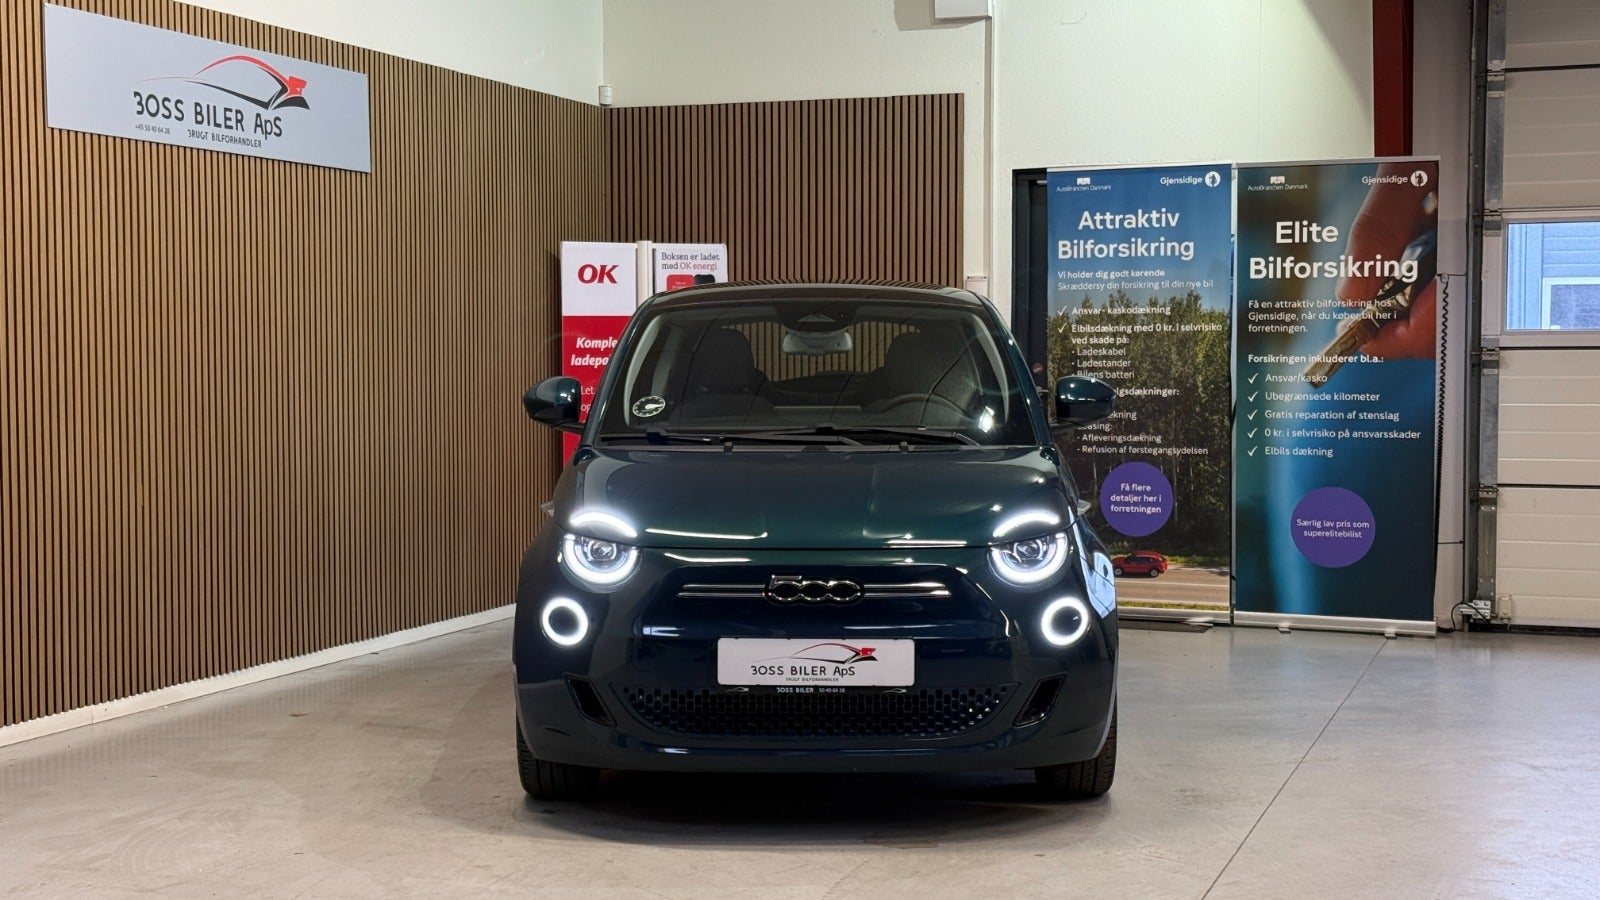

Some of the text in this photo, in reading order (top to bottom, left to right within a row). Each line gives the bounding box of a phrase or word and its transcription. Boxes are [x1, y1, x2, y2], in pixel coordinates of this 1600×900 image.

[194, 101, 245, 132] BILER
[254, 112, 283, 140] ApS
[211, 132, 262, 148] BILFORHANDLER
[1160, 176, 1203, 187] Gjensidige
[1361, 175, 1408, 186] Gjensidige
[1078, 207, 1180, 230] Attraktiv
[1276, 220, 1339, 244] Elite
[1058, 237, 1195, 261] Bilforsikring
[661, 252, 689, 261] Boksen
[661, 262, 717, 272] med OK energi
[1249, 254, 1418, 283] Bilforsikring
[577, 263, 619, 284] OK
[1058, 269, 1165, 281] Vi holder dig godt kørende
[1058, 279, 1213, 292] Skræddersy din forsikring til din nye bil
[1248, 298, 1392, 310] Få en attraktiv bilforsikring hos
[1107, 305, 1171, 317] kaskodækning
[1248, 311, 1299, 323] Gjensidige,
[1301, 310, 1317, 320] når
[1318, 311, 1331, 320] du
[1332, 310, 1360, 320] køber
[1362, 310, 1374, 320] bil
[1375, 310, 1393, 320] her
[1072, 324, 1132, 335] Elbilsdækning
[1134, 323, 1153, 333] med
[1155, 323, 1161, 332] 0
[1163, 323, 1175, 332] kr.
[1180, 322, 1222, 332] selvrisiko
[1248, 324, 1308, 334] forretningen.
[576, 336, 618, 352] Komple
[1072, 335, 1130, 346] ved skade på:
[1077, 347, 1126, 356] Ladeskabel
[570, 354, 612, 369] ladepa
[1077, 359, 1131, 368] Ladestander
[1248, 354, 1384, 364] Forsikringen inkluderer bl.a.:
[1105, 370, 1135, 379] batteri
[1265, 373, 1328, 383] Ansvar/kasko
[580, 385, 596, 395] Let
[1265, 391, 1380, 403] Ubegrænsede kilometer
[1264, 410, 1400, 422] Gratis reparation af stenslag
[1077, 423, 1113, 432] asing:
[1082, 433, 1162, 443] Afleveringsdækning
[1264, 429, 1271, 437] 0
[1273, 428, 1285, 437] kr.
[1291, 428, 1336, 438] selvrisiko
[1338, 429, 1350, 440] på
[1352, 429, 1421, 439] ansvarsskader
[1082, 445, 1208, 456] Refusion af førstegangsydelsen
[1264, 446, 1334, 458] Elbils dækning
[1120, 482, 1152, 491] Få flere
[1110, 494, 1142, 503] detaljer
[1143, 494, 1157, 502] her
[1110, 504, 1162, 515] forretningen
[1296, 518, 1370, 530] Særlig lav pris som
[1303, 529, 1363, 538] superelitebilist
[766, 575, 863, 602] 500
[790, 665, 827, 676] BILER
[833, 666, 856, 678] ApS
